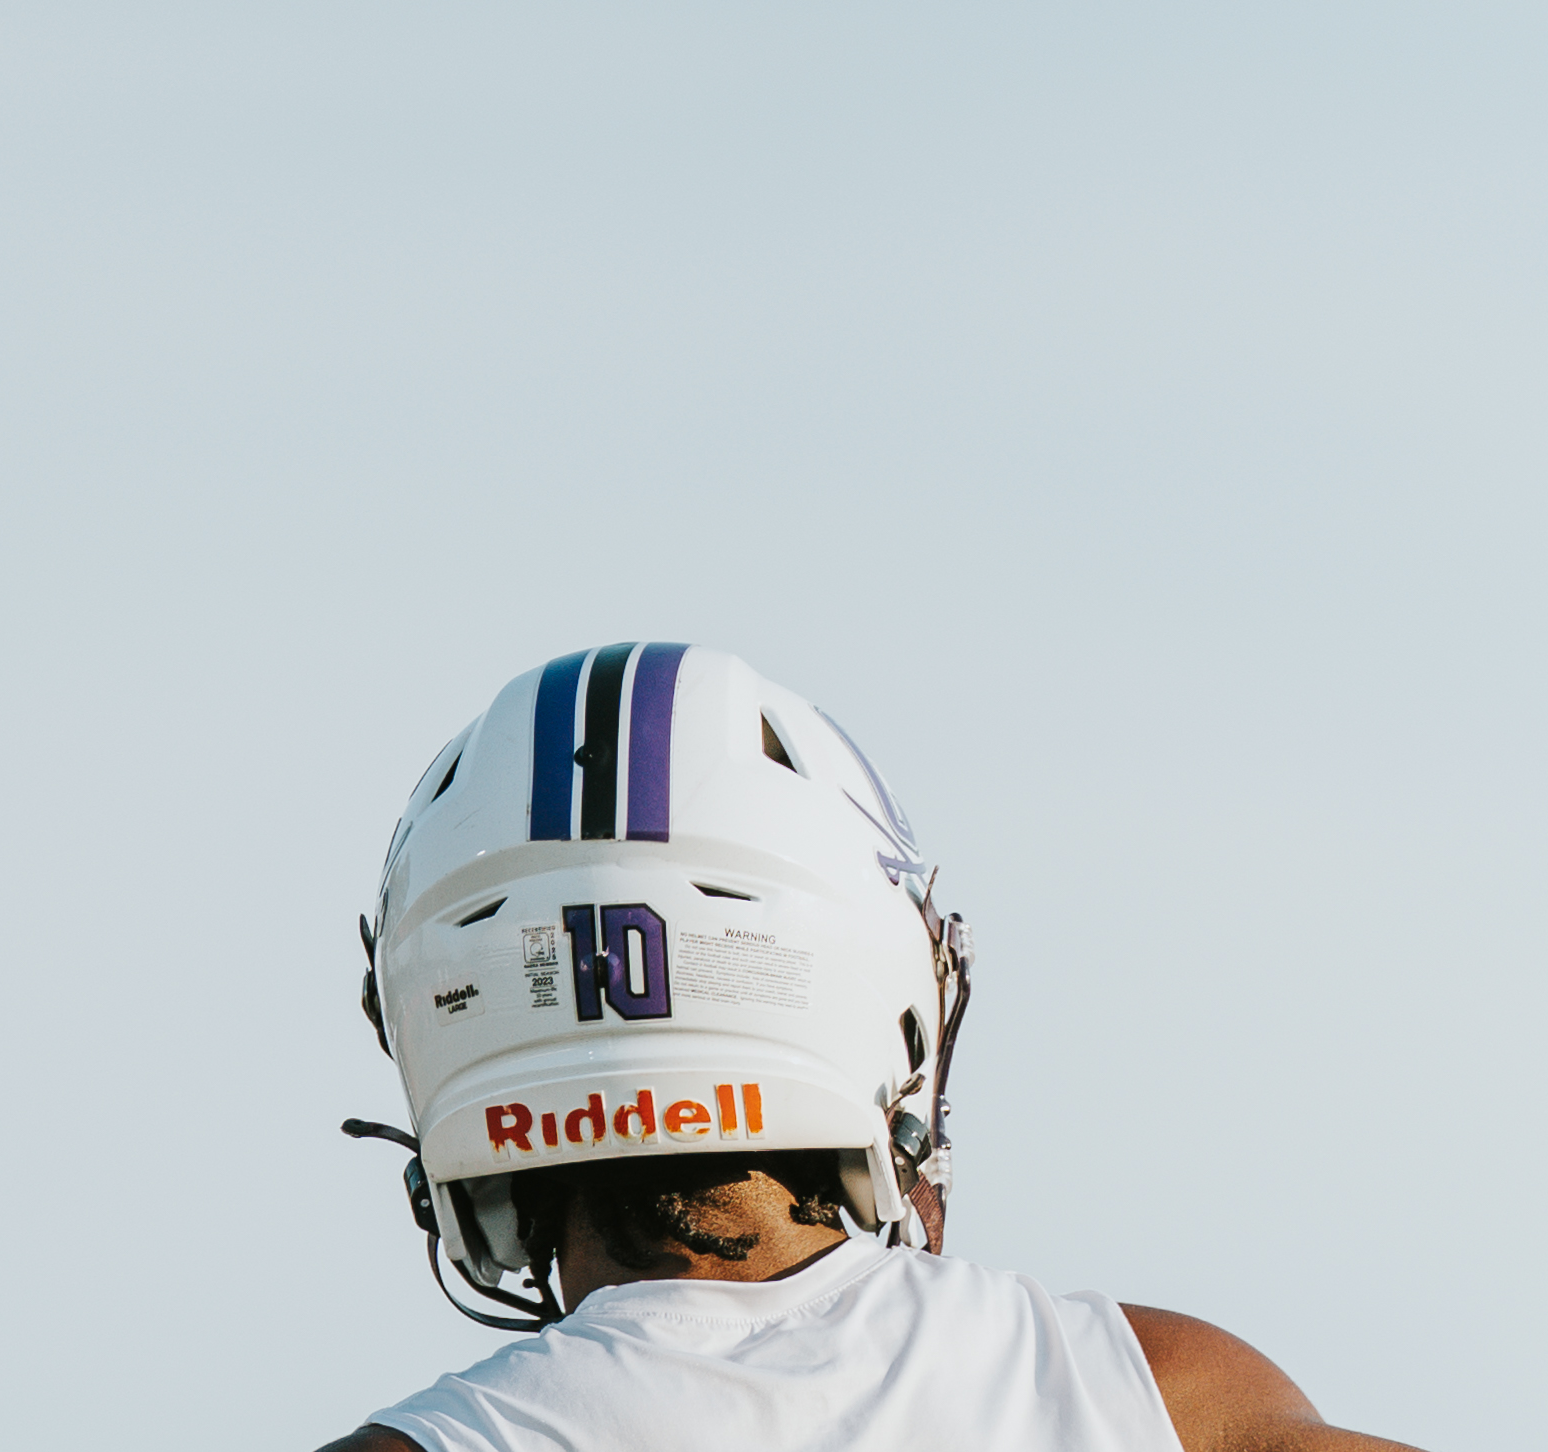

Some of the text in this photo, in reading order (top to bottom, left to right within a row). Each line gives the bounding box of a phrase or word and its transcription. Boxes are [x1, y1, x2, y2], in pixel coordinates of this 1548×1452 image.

[724, 927, 777, 945] WARNING
[562, 903, 672, 1022] 10
[531, 976, 554, 987] 2023
[434, 983, 476, 1009] Riddell
[485, 1083, 766, 1160] Riddell
